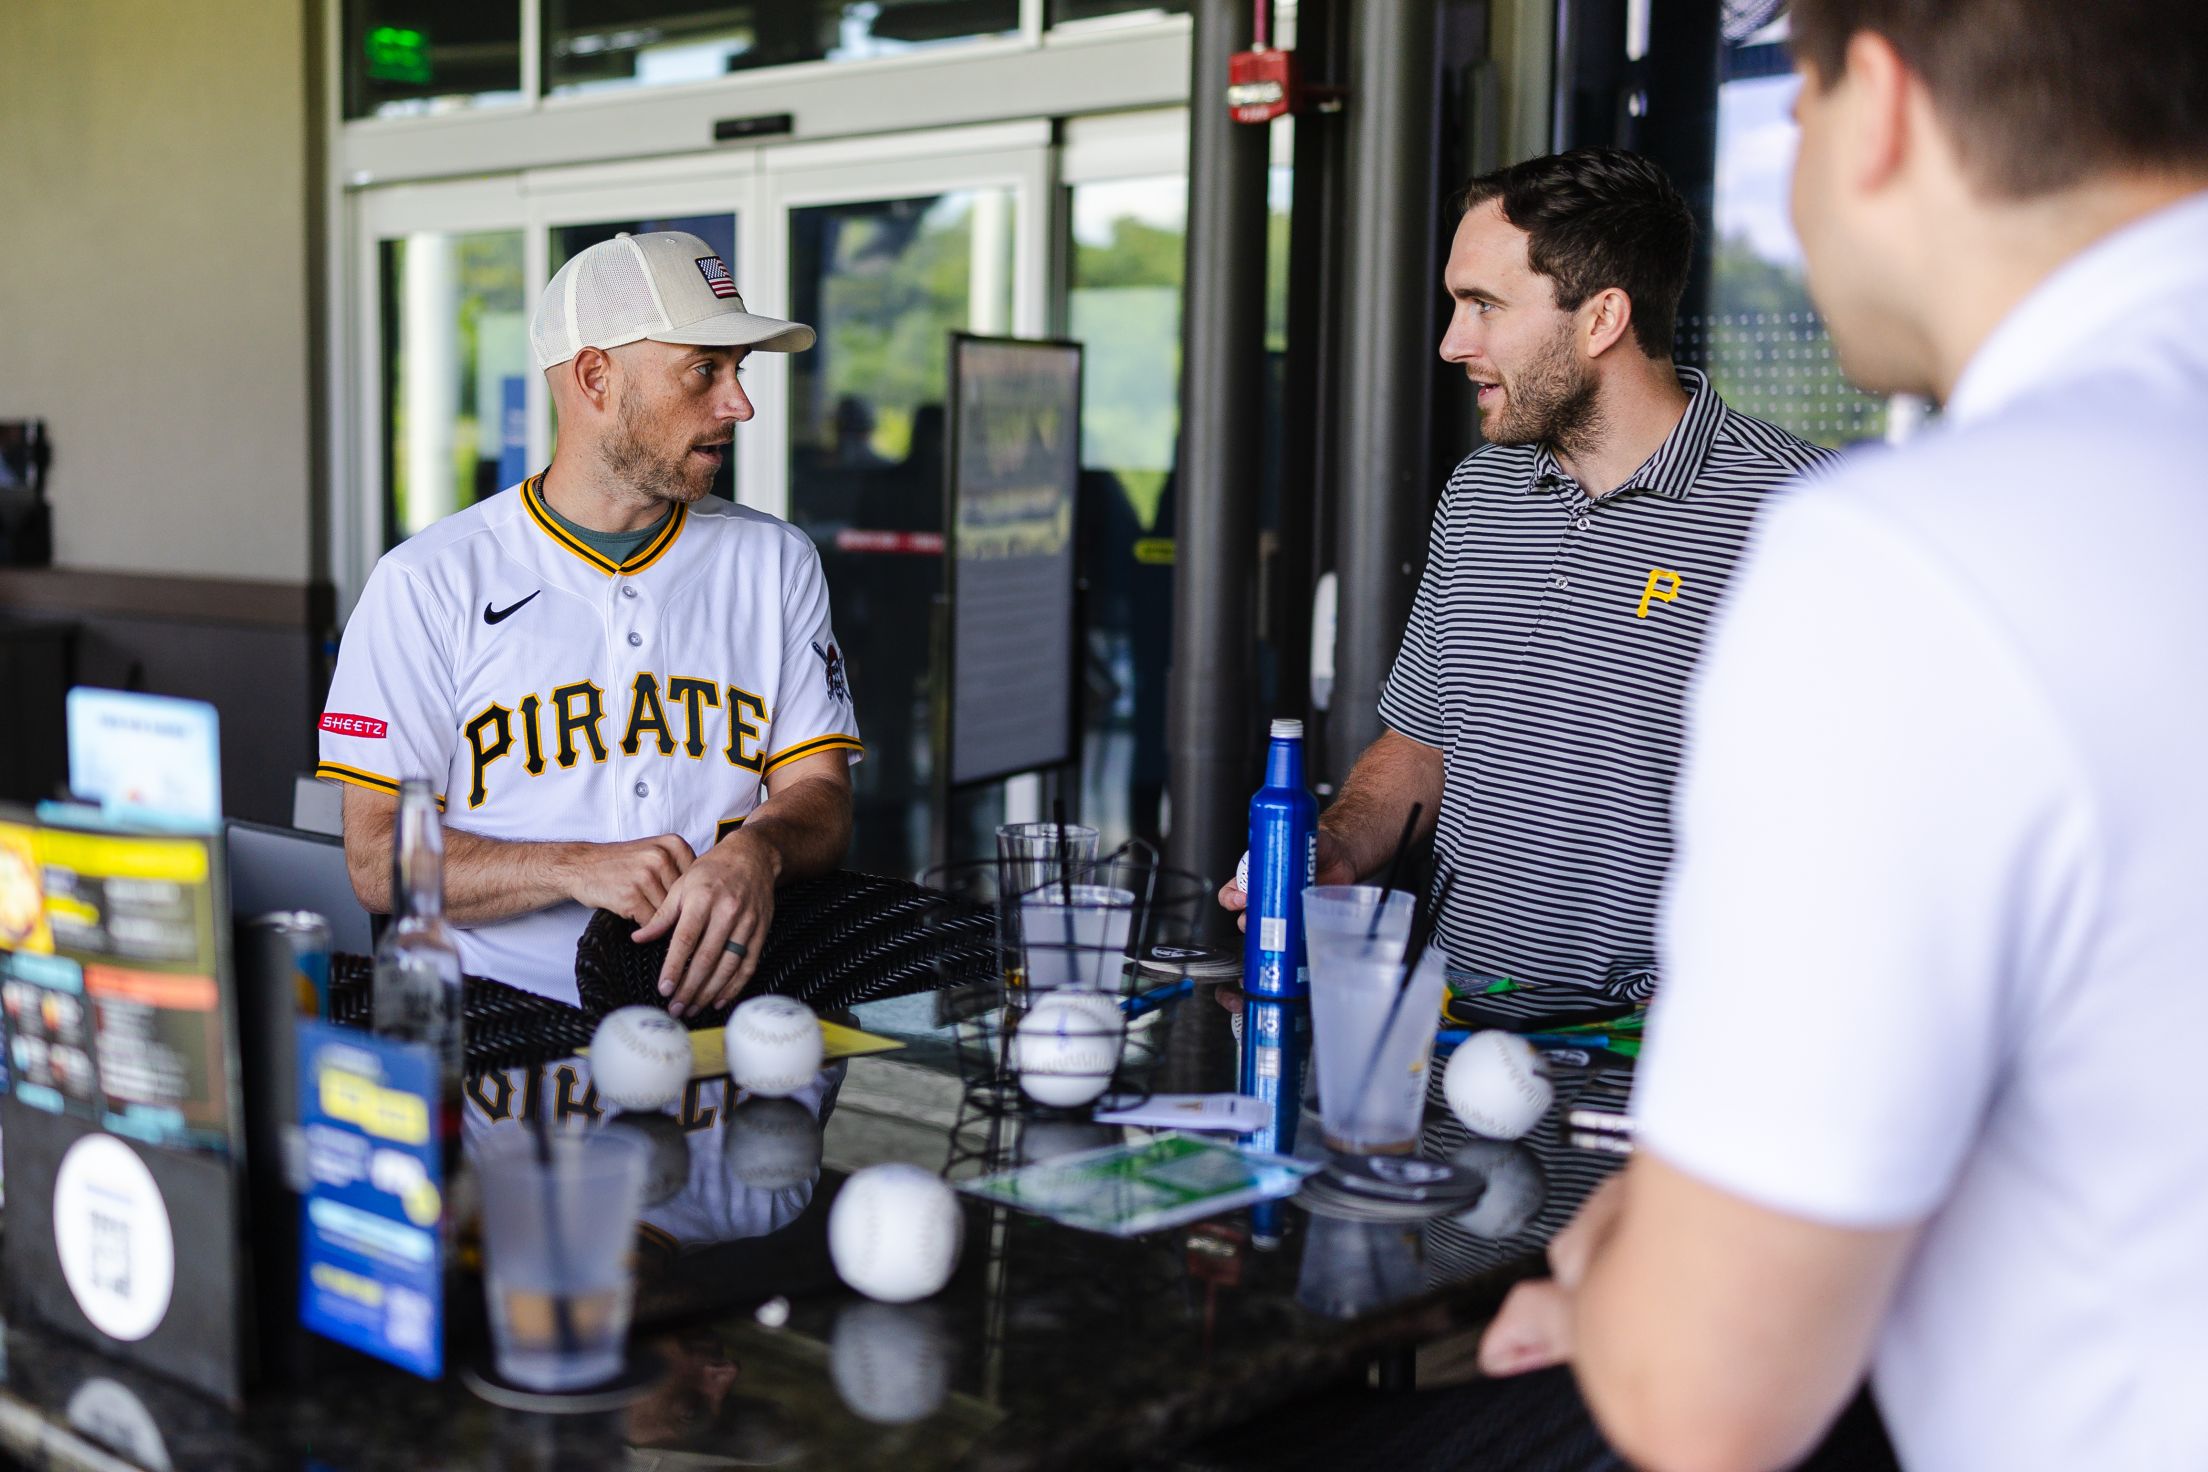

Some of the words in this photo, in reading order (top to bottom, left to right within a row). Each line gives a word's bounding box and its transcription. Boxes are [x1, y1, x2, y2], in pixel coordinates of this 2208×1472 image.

[1637, 568, 1683, 618] P
[322, 716, 383, 736] SHEETZ
[463, 671, 775, 810] PIRATE
